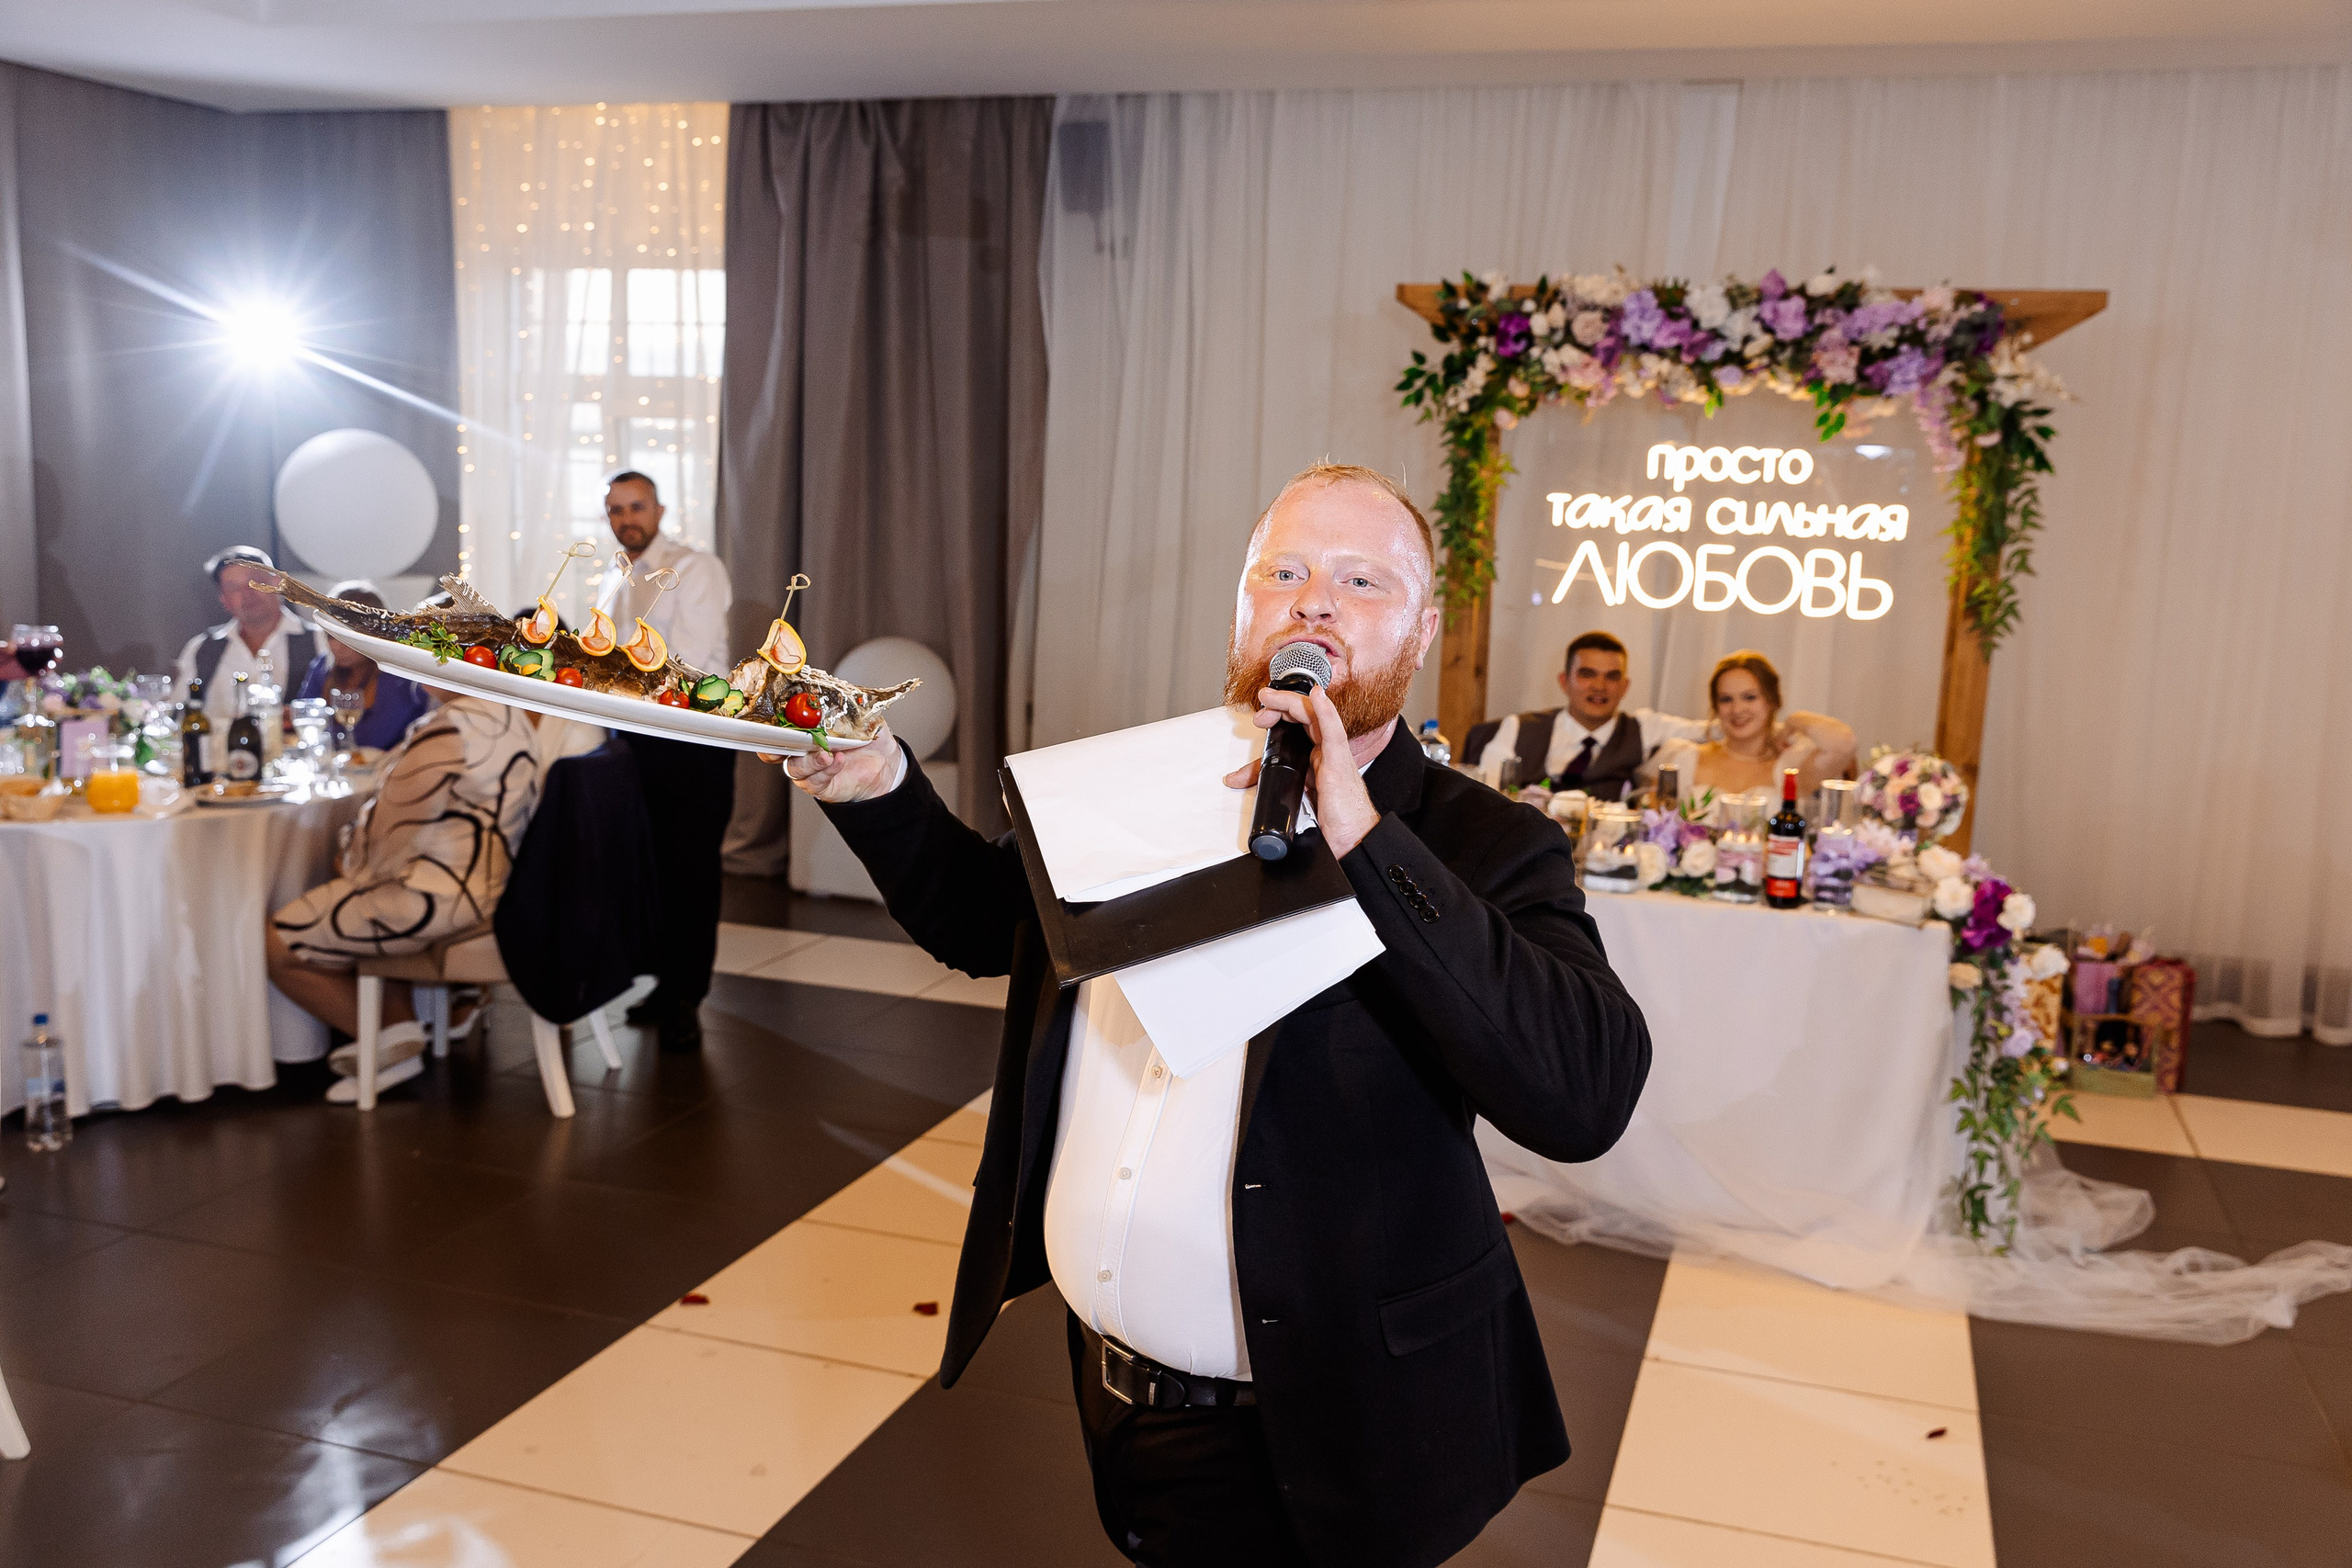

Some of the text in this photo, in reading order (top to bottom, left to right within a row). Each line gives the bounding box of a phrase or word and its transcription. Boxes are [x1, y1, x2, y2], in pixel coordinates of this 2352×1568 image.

[1646, 444, 1814, 492] просто
[1546, 492, 1909, 542] такая сильная
[1551, 539, 1894, 621] ЛЮБОВЬ
